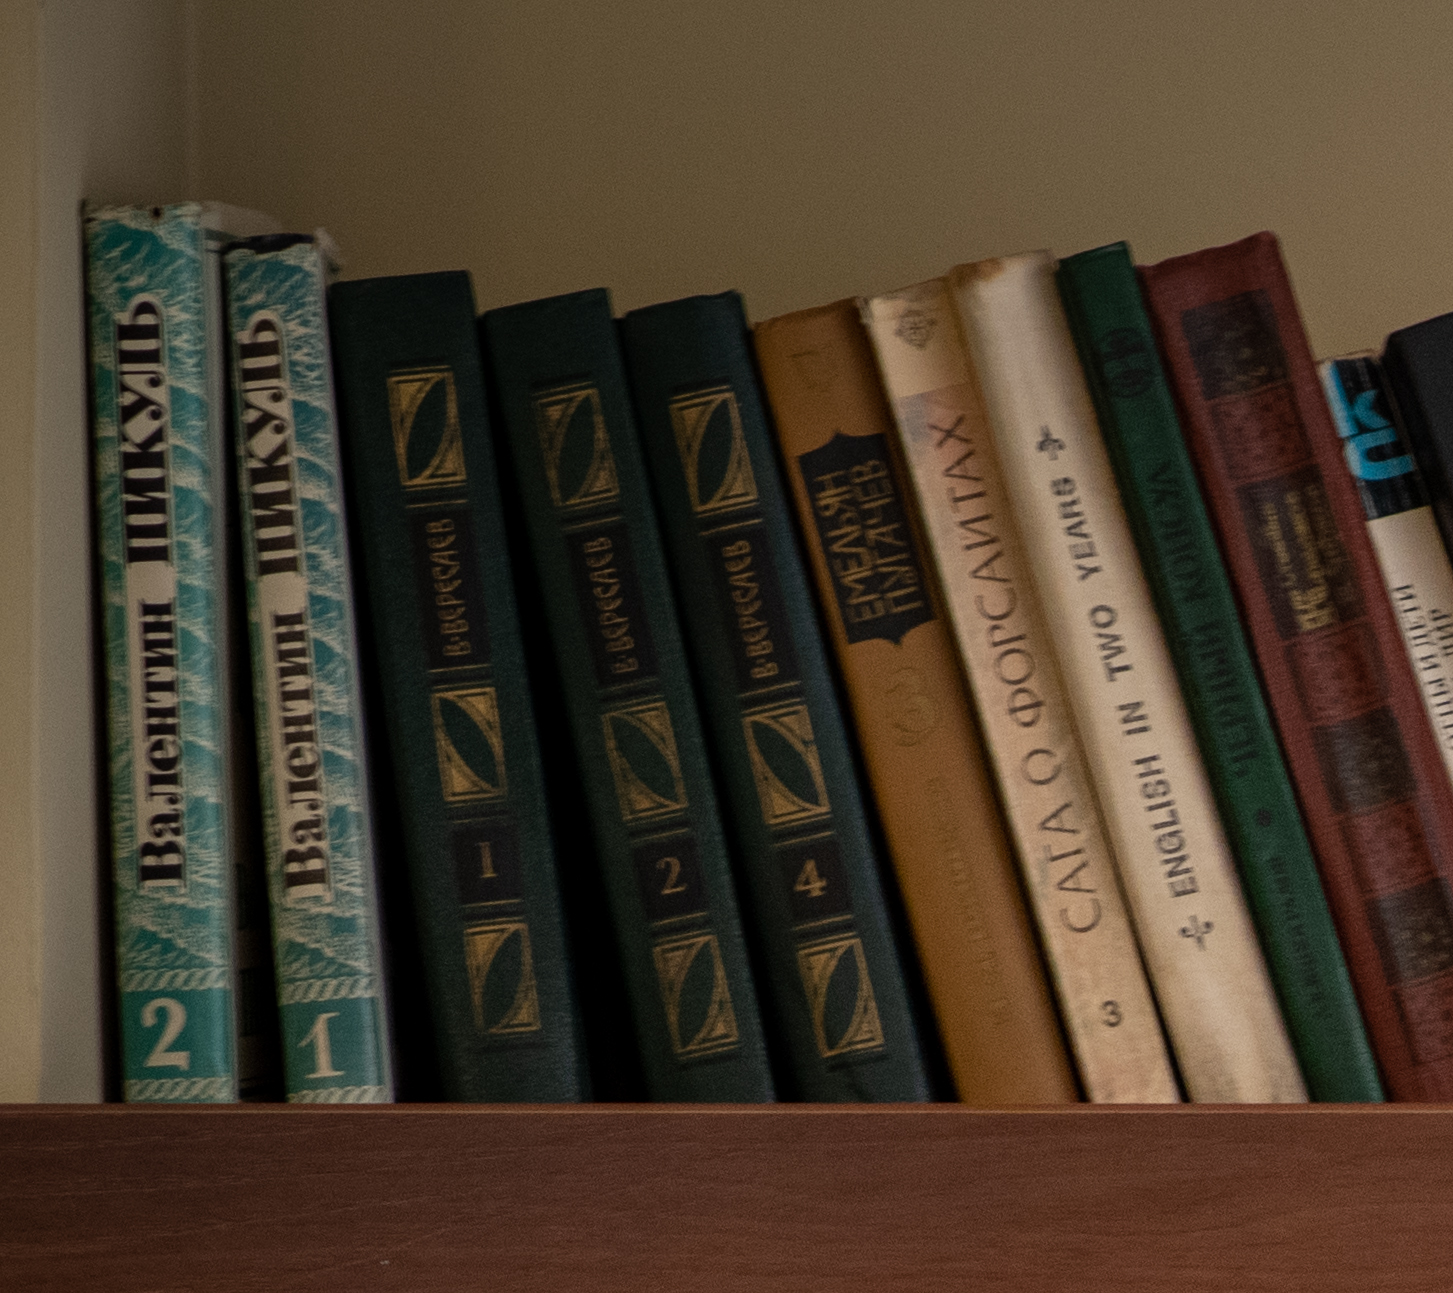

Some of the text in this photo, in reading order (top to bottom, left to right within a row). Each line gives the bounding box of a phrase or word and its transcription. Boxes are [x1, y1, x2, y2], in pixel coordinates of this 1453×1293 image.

[114, 300, 186, 883] Валентин ПИКУЛЬ
[235, 317, 328, 889] Валентин ПИКУЛЬ
[1046, 472, 1199, 899] ENGLISH IN TWO YEARS
[1017, 744, 1065, 789] О
[796, 863, 829, 897] 4
[1033, 802, 1106, 937] САГА
[141, 996, 190, 1071] 2
[297, 1012, 346, 1078] 1
